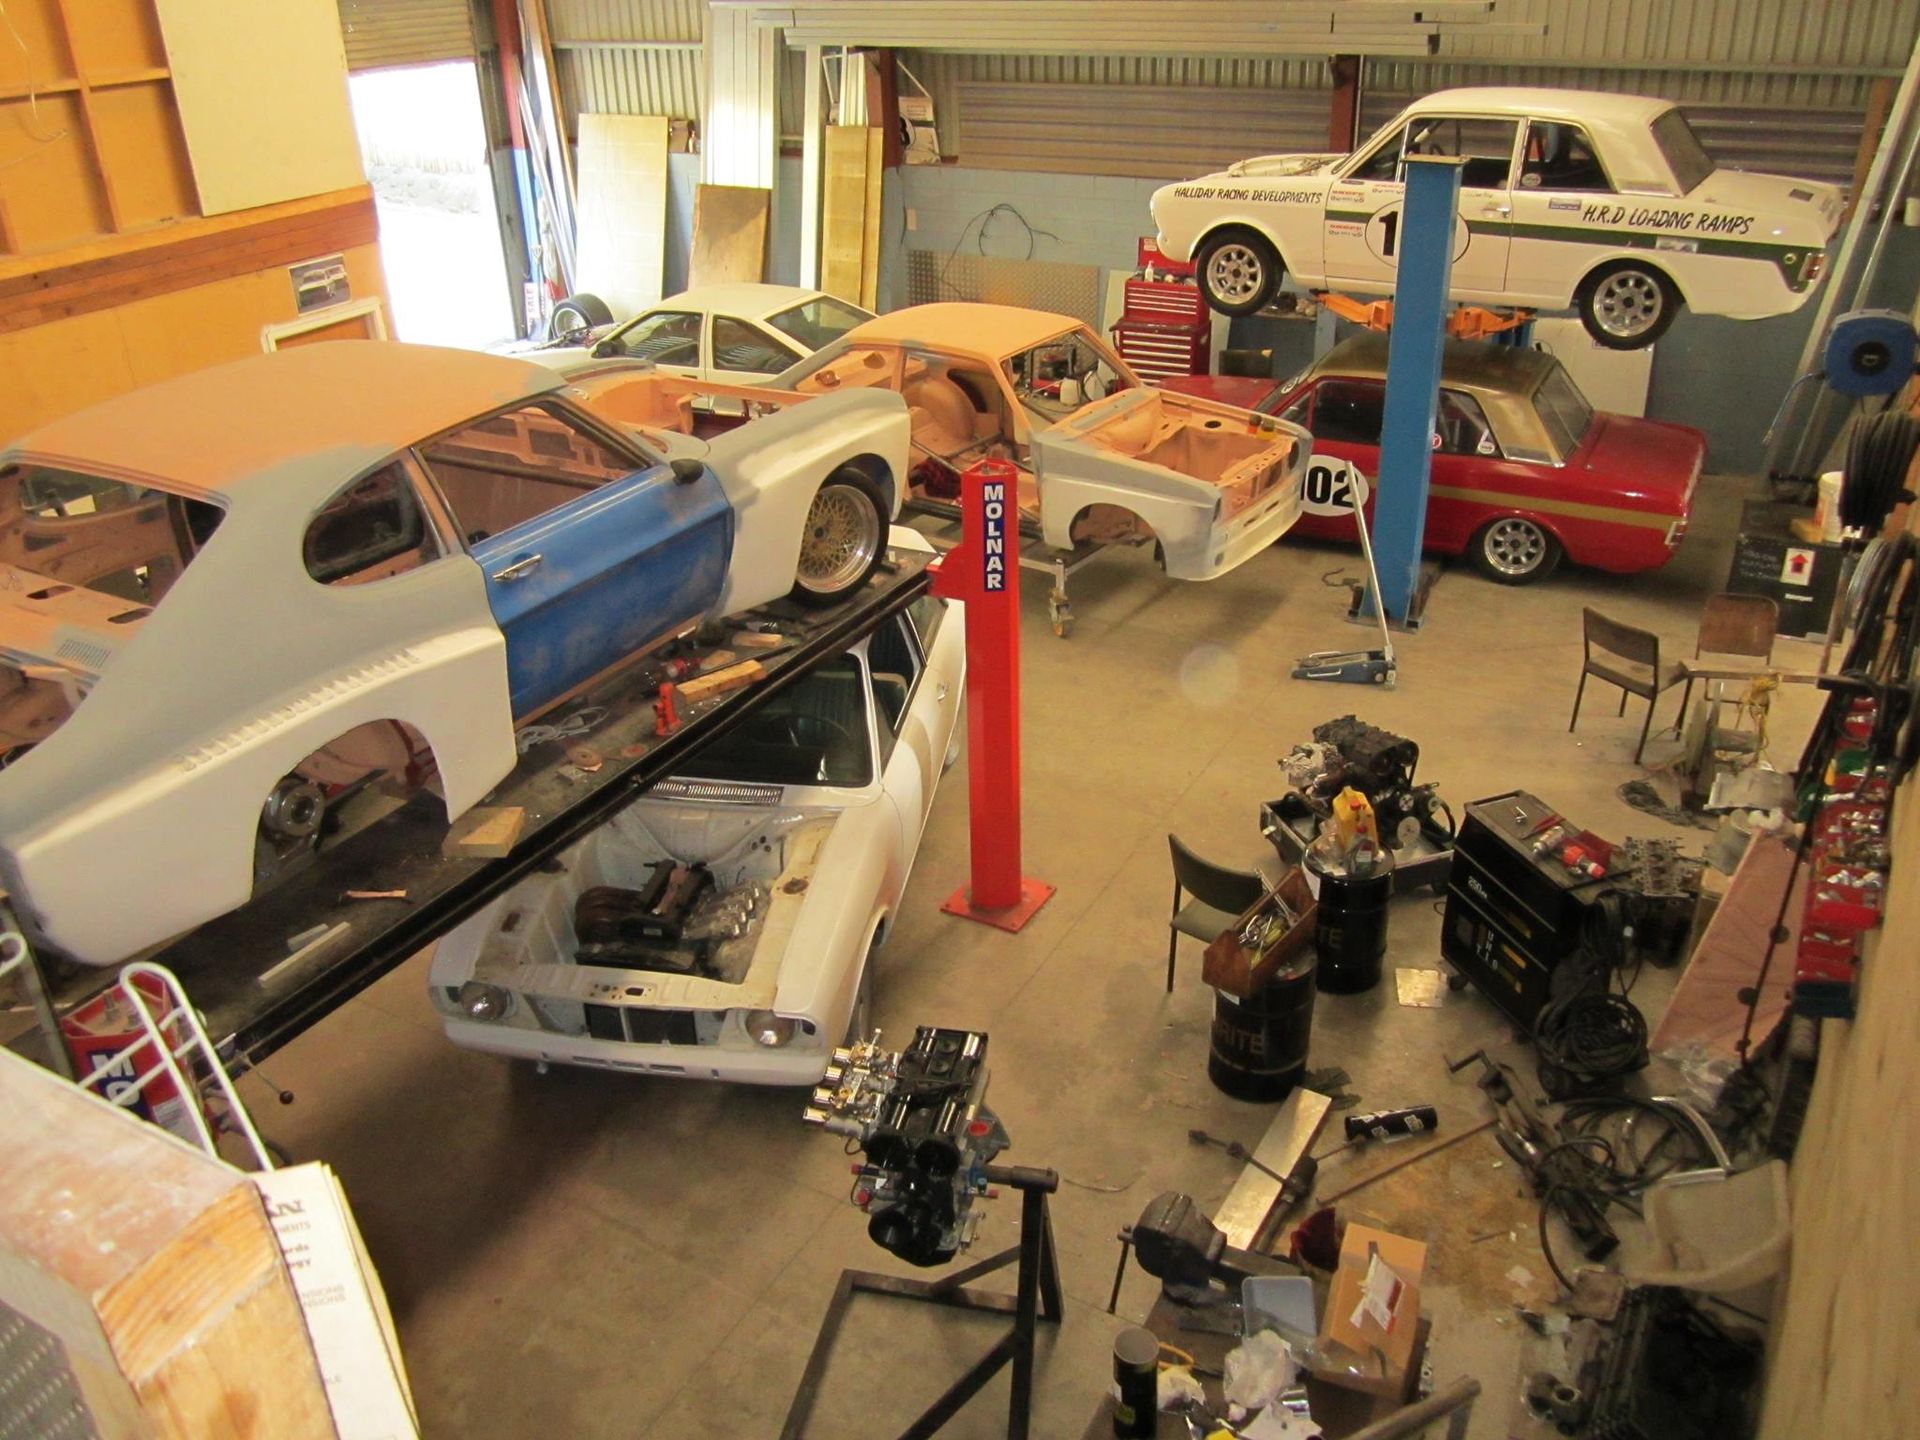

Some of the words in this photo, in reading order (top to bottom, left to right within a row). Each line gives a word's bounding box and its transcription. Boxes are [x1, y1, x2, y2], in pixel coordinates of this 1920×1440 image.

[1174, 187, 1215, 199] HALLIDAY
[1217, 188, 1249, 201] RACING
[1251, 189, 1323, 204] DEVELOPMENTS
[1582, 204, 1625, 224] H.R.D
[1628, 207, 1694, 231] LOADING
[1696, 214, 1754, 235] RAMPS
[983, 484, 1004, 589] MOLNAR
